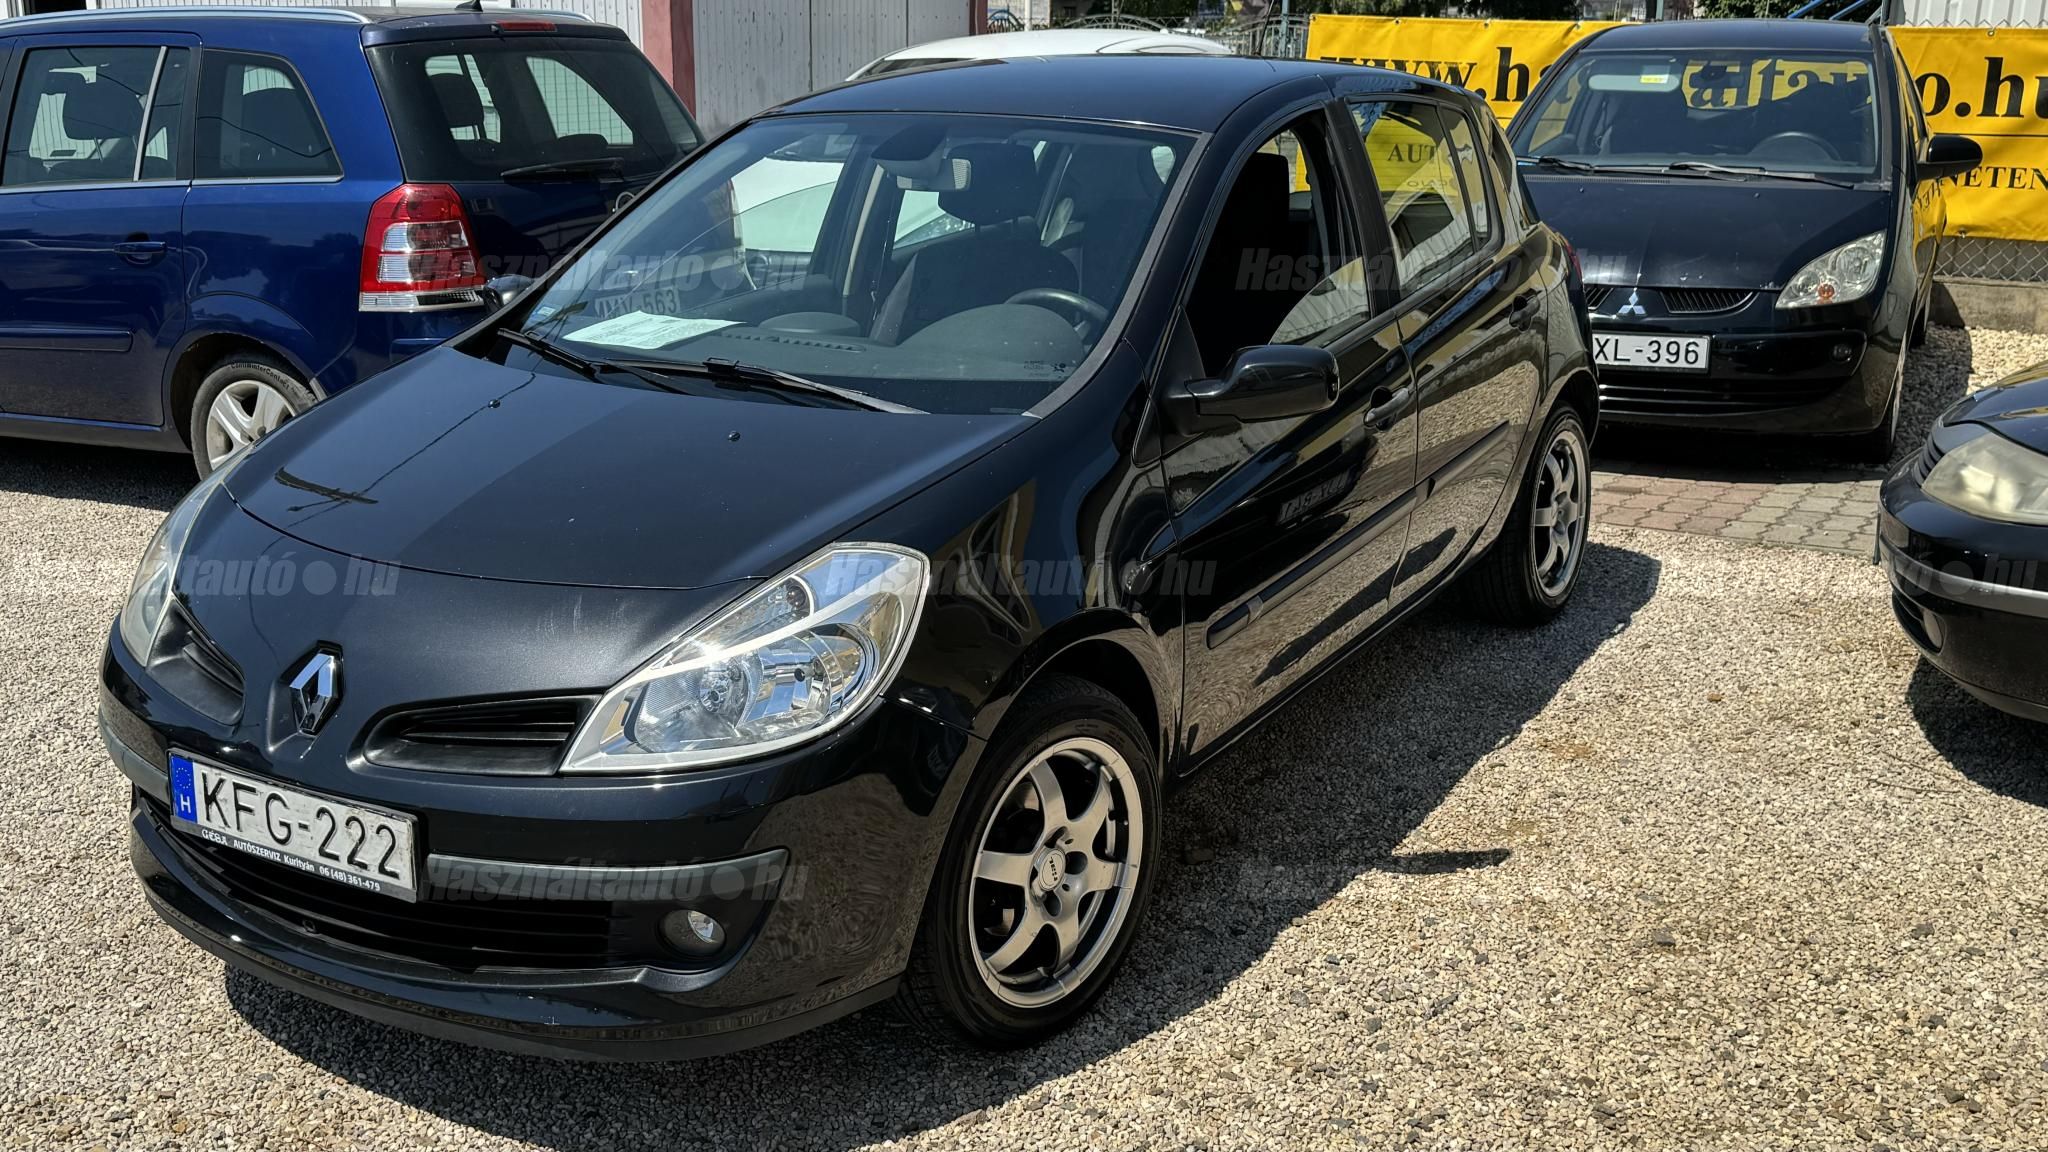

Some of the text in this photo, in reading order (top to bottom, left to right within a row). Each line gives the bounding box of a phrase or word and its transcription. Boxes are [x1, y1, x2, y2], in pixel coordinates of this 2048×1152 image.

[1946, 166, 2048, 190] ETEN
[1594, 337, 1700, 364] XL-396
[180, 794, 192, 814] H
[201, 770, 401, 880] KFG-222
[233, 839, 281, 862] AUTÓSZERVIZ
[319, 866, 330, 877] 06
[348, 872, 381, 891] 361-479
